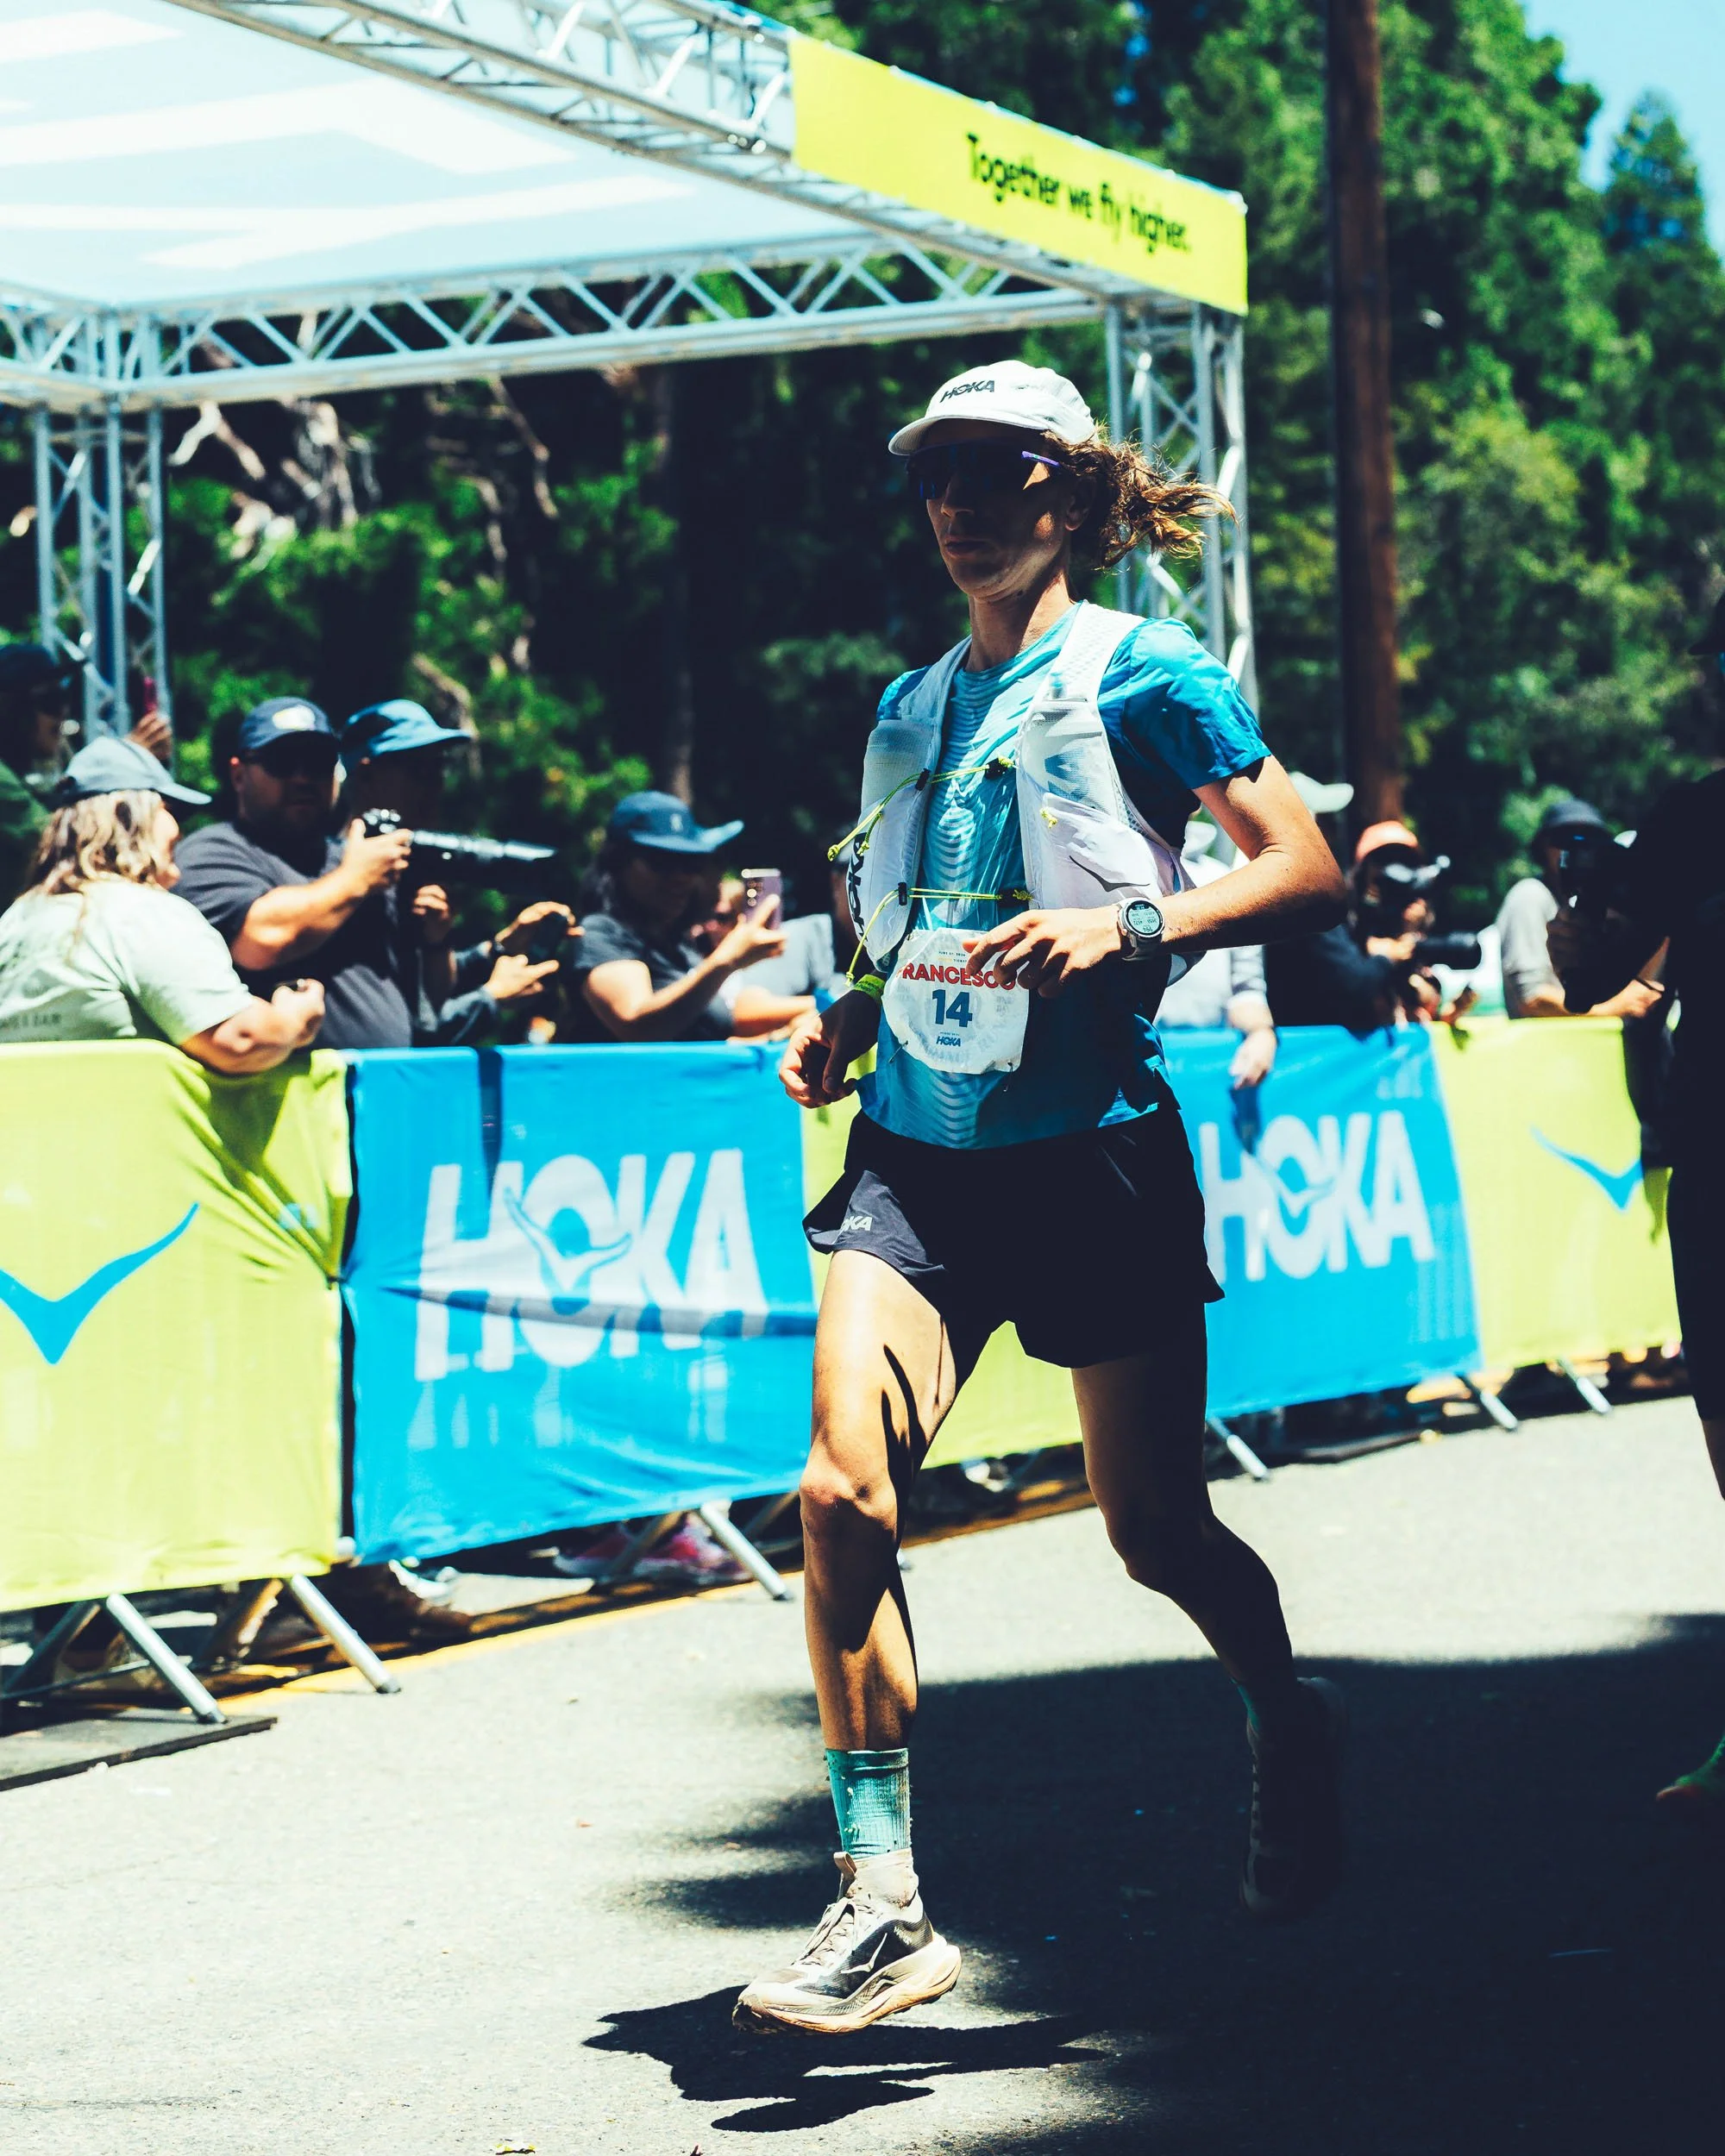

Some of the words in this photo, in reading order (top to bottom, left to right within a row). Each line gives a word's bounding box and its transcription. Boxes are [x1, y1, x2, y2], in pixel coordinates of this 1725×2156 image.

[967, 132, 1060, 204] Together
[1069, 185, 1093, 219] we
[1101, 181, 1121, 244] fly
[939, 379, 995, 403] HOKA
[896, 962, 1018, 990] RANCESC
[932, 988, 973, 1027] 14
[936, 1036, 961, 1047] HOKA
[1198, 1109, 1437, 1284] HOKA
[841, 1215, 873, 1232] OKA
[414, 1147, 769, 1382] HOKA
